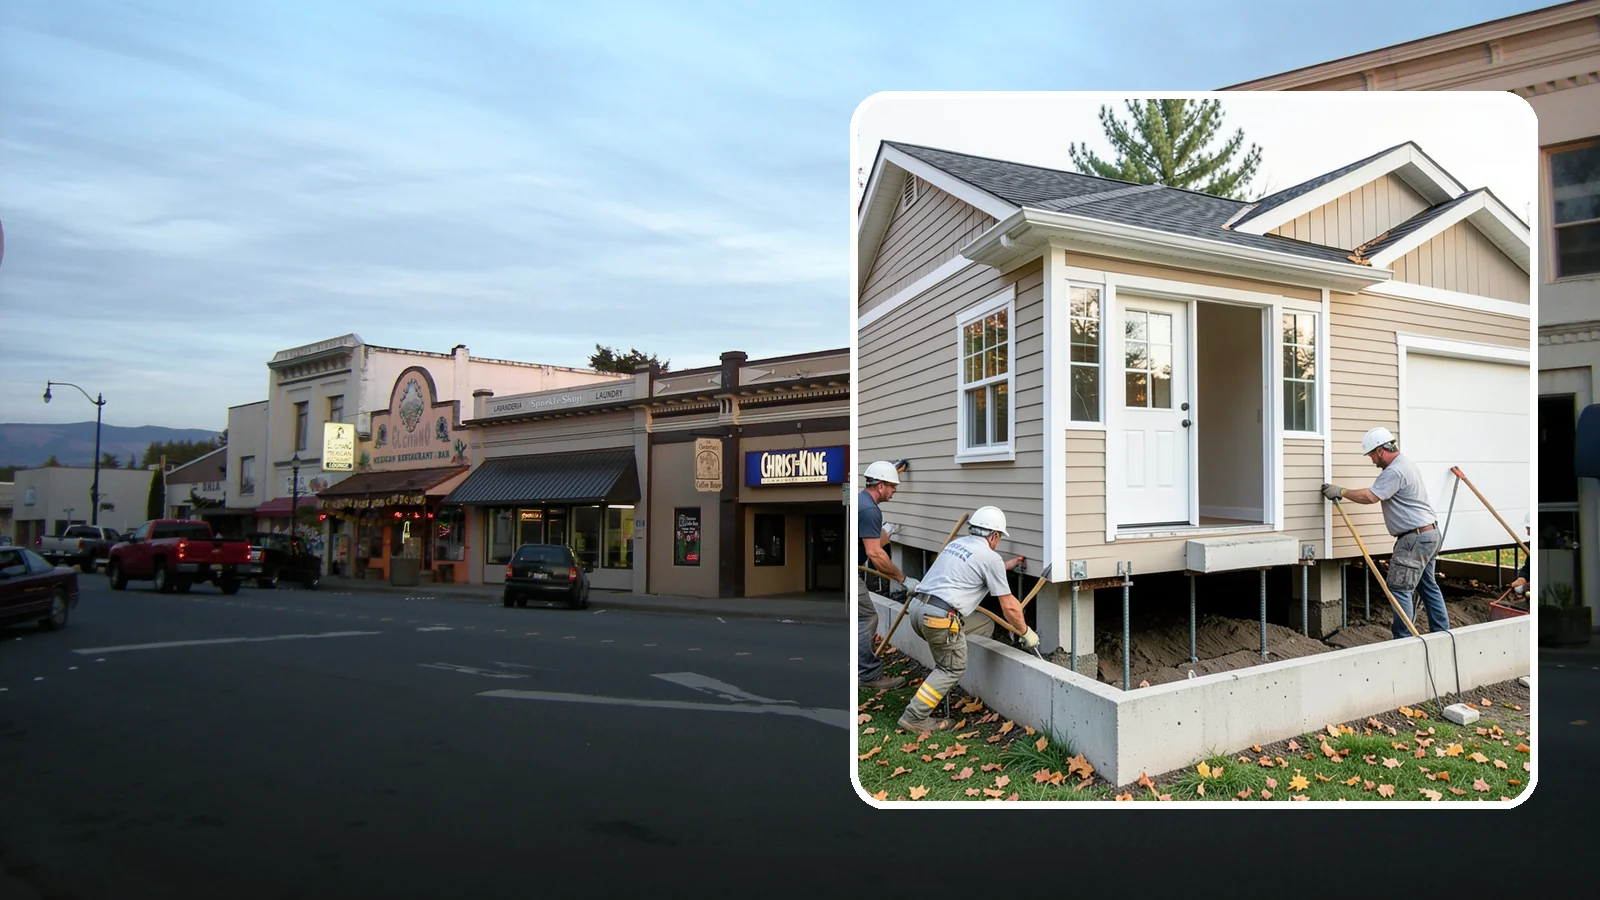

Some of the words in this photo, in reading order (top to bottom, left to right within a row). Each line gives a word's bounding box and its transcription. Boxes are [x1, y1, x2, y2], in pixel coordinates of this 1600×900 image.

[595, 389, 624, 400] LAUNDRY
[493, 402, 523, 413] LAVANDERIA
[530, 397, 559, 408] Sparkle
[561, 395, 582, 407] Shop
[374, 455, 396, 464] MEXICAN
[398, 451, 433, 462] RESTAURANT
[437, 450, 450, 460] BAR
[761, 452, 797, 478] CHRIST
[799, 450, 828, 477] KING
